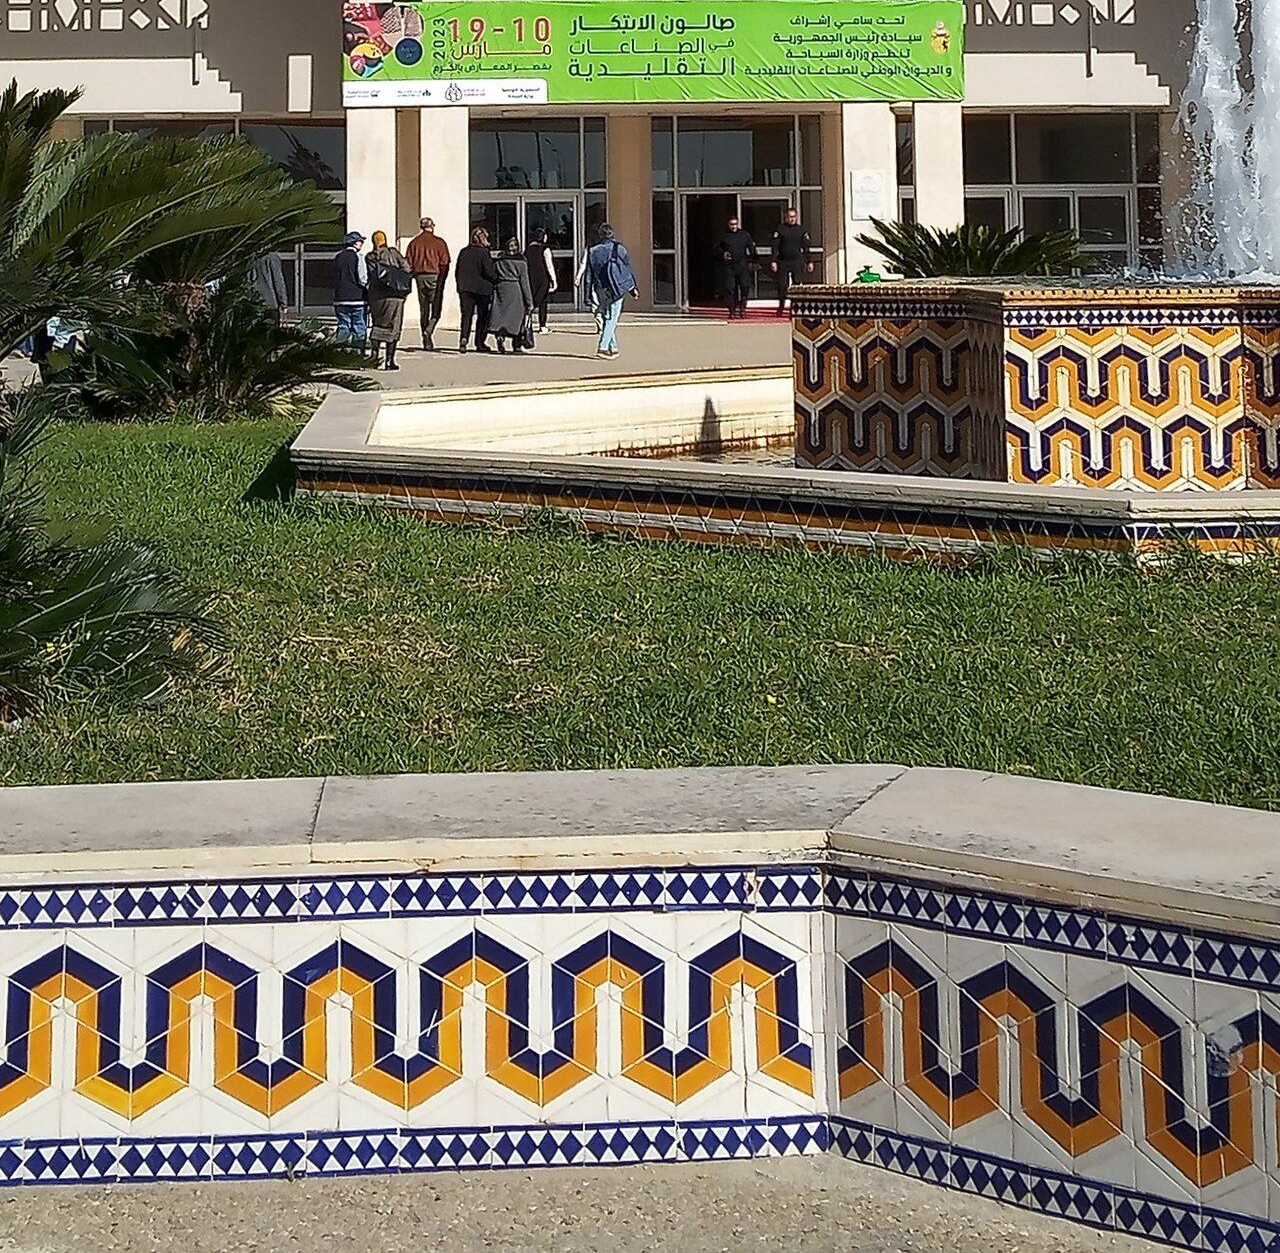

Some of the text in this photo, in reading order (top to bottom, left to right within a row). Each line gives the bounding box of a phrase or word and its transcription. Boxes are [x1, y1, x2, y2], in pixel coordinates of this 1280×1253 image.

[660, 14, 735, 36] صالون
[789, 15, 905, 29] تحت سامي إشراف
[433, 18, 446, 60] 2023
[773, 32, 922, 45] سيادة رئيس الجمهورية
[451, 40, 552, 61] مارس
[569, 38, 735, 55] في الصناعات
[786, 49, 844, 61] السياحة
[846, 49, 870, 61] وزارة
[569, 56, 735, 82] التقليدية
[744, 65, 796, 77] التقليدية
[797, 65, 859, 76] للصناعات
[860, 65, 902, 78] الوطني
